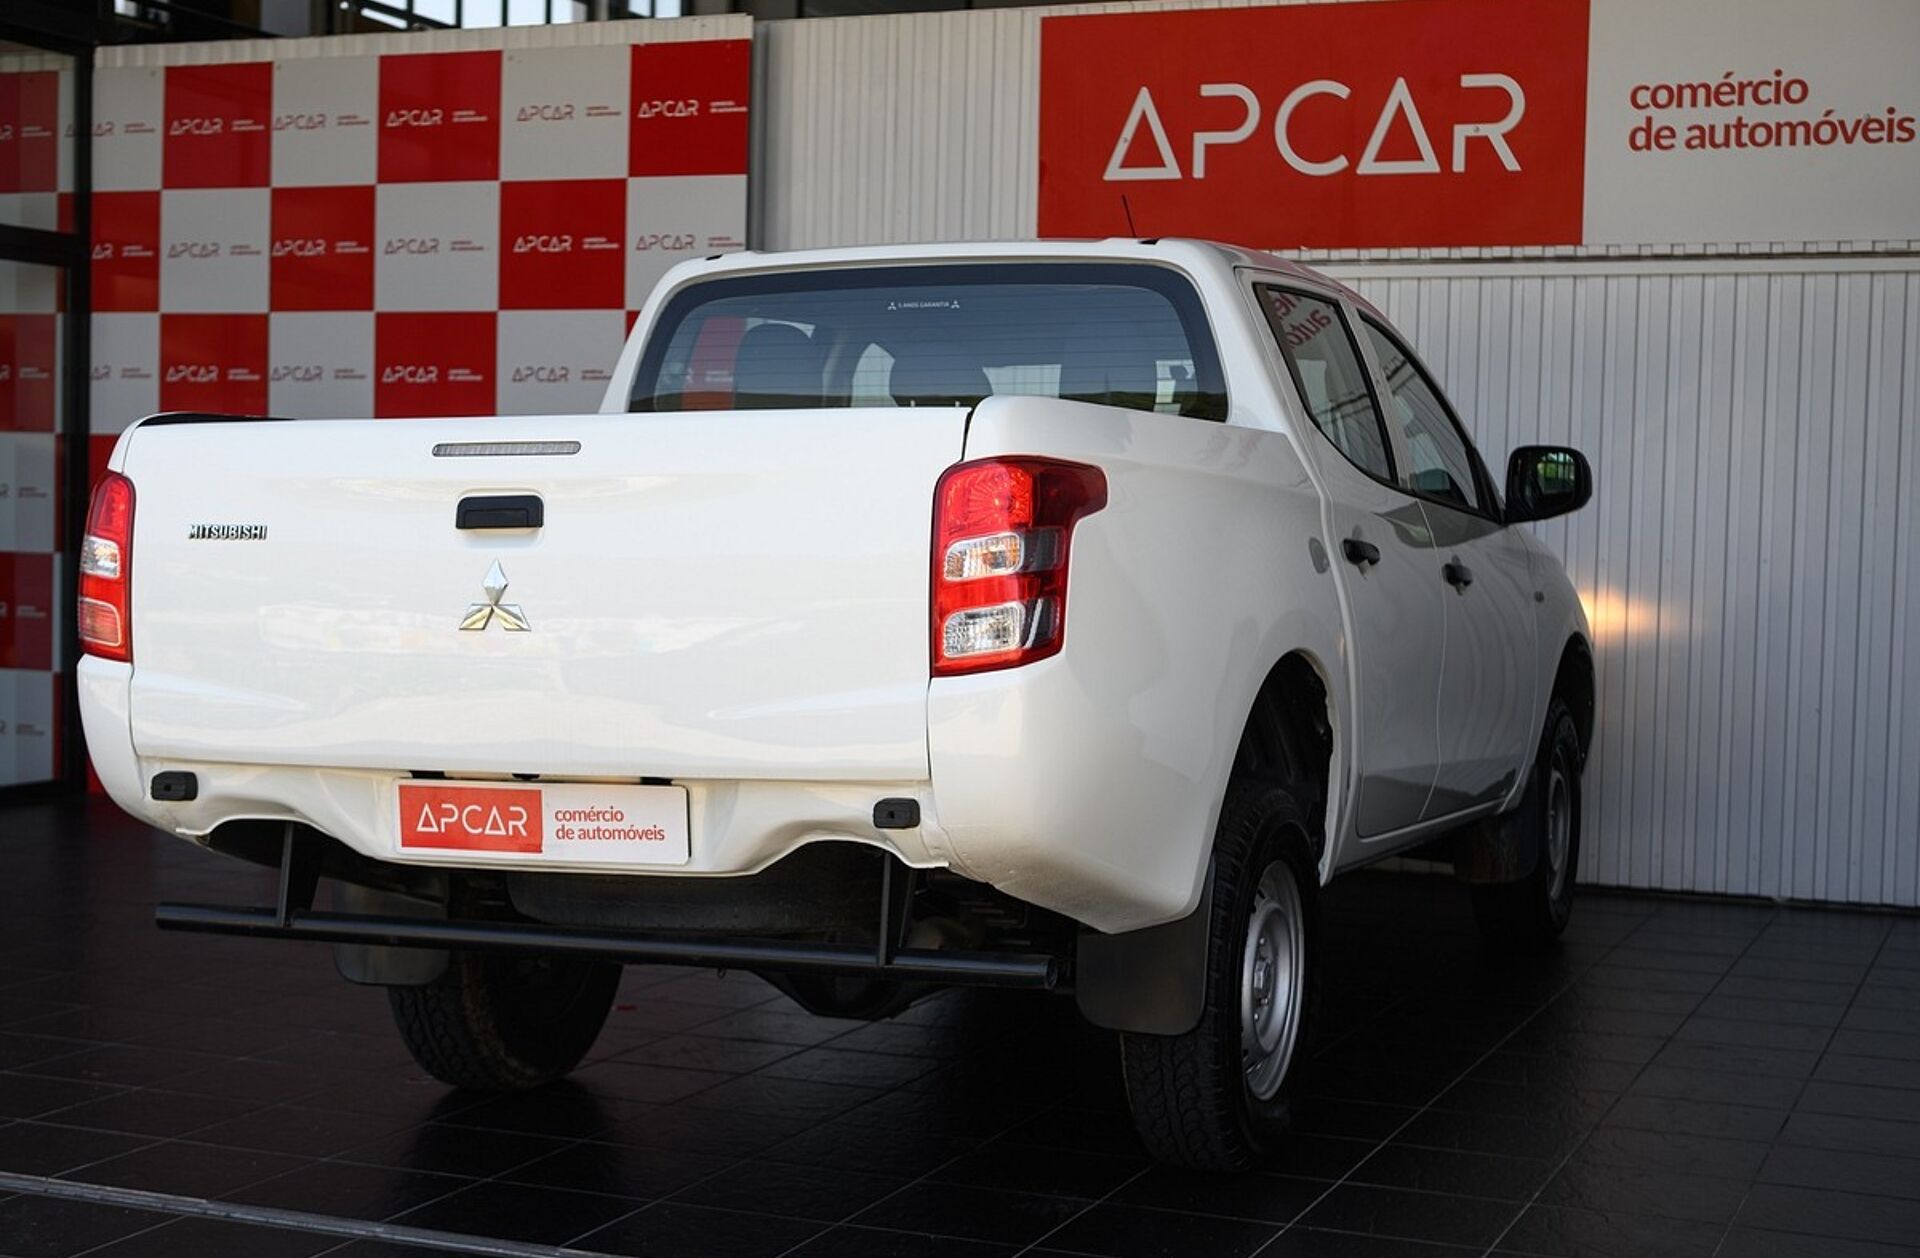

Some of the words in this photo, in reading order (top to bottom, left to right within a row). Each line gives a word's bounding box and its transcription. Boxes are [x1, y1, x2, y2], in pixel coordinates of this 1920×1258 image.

[1630, 69, 1809, 111] comércio
[386, 109, 443, 127] APCAR
[516, 104, 574, 121] APCAR
[638, 100, 699, 118] APCAR
[168, 118, 224, 136] APCAR
[271, 114, 326, 131] APCAR
[1103, 74, 1525, 181] APCAR
[1628, 115, 1677, 152] de
[1684, 107, 1916, 151] automóveis
[167, 243, 220, 258] APCAR
[271, 239, 326, 257] APCAR
[384, 238, 440, 255] APCAR
[513, 235, 573, 253] APCAR
[635, 234, 696, 251] APCAR
[166, 365, 219, 383] APCAR
[270, 366, 324, 382] APCAR
[382, 366, 438, 384] APCAR
[511, 366, 569, 383] APCAR
[188, 524, 268, 540] MITSUBISHI
[416, 803, 528, 836] APCAR
[555, 806, 624, 823] comércio
[556, 824, 575, 841] de
[577, 825, 665, 842] automóveis
